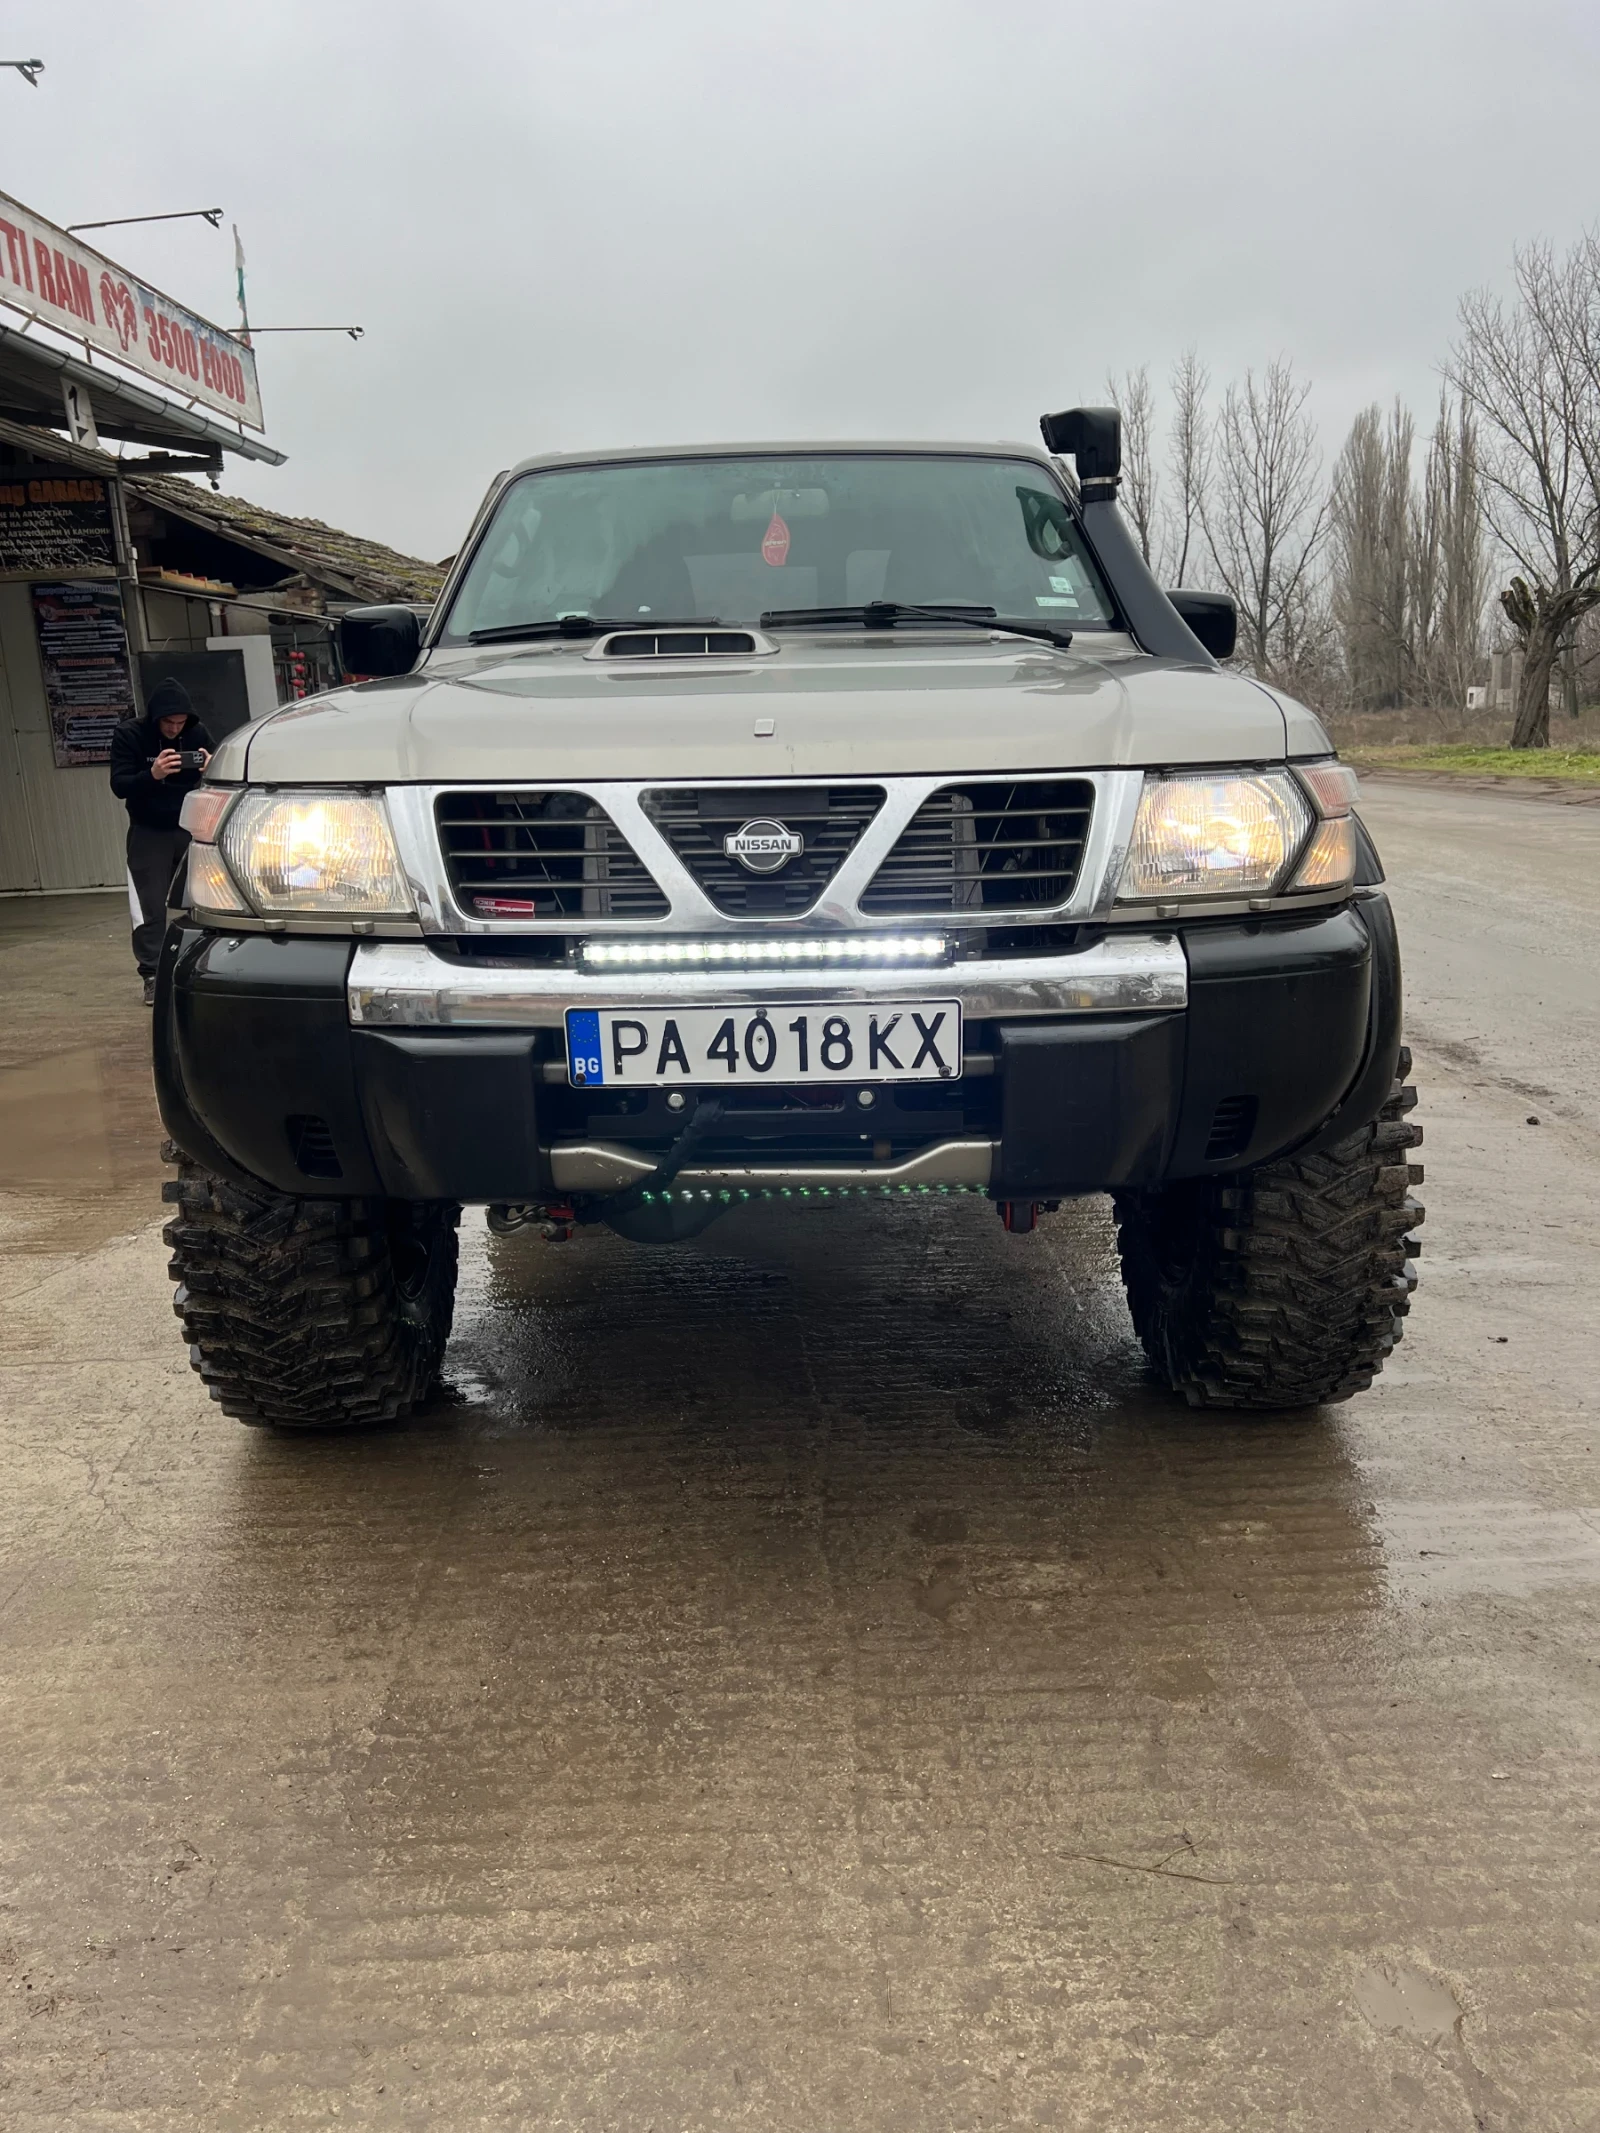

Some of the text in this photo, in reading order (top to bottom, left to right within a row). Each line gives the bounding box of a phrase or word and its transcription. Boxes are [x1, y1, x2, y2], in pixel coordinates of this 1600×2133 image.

[0, 217, 34, 294] TI
[33, 237, 96, 326] RAM
[143, 306, 199, 382] 3500
[28, 480, 105, 503] GARAGE
[735, 839, 792, 851] NISSAN
[574, 1012, 948, 1076] BG PA 4018 KX
